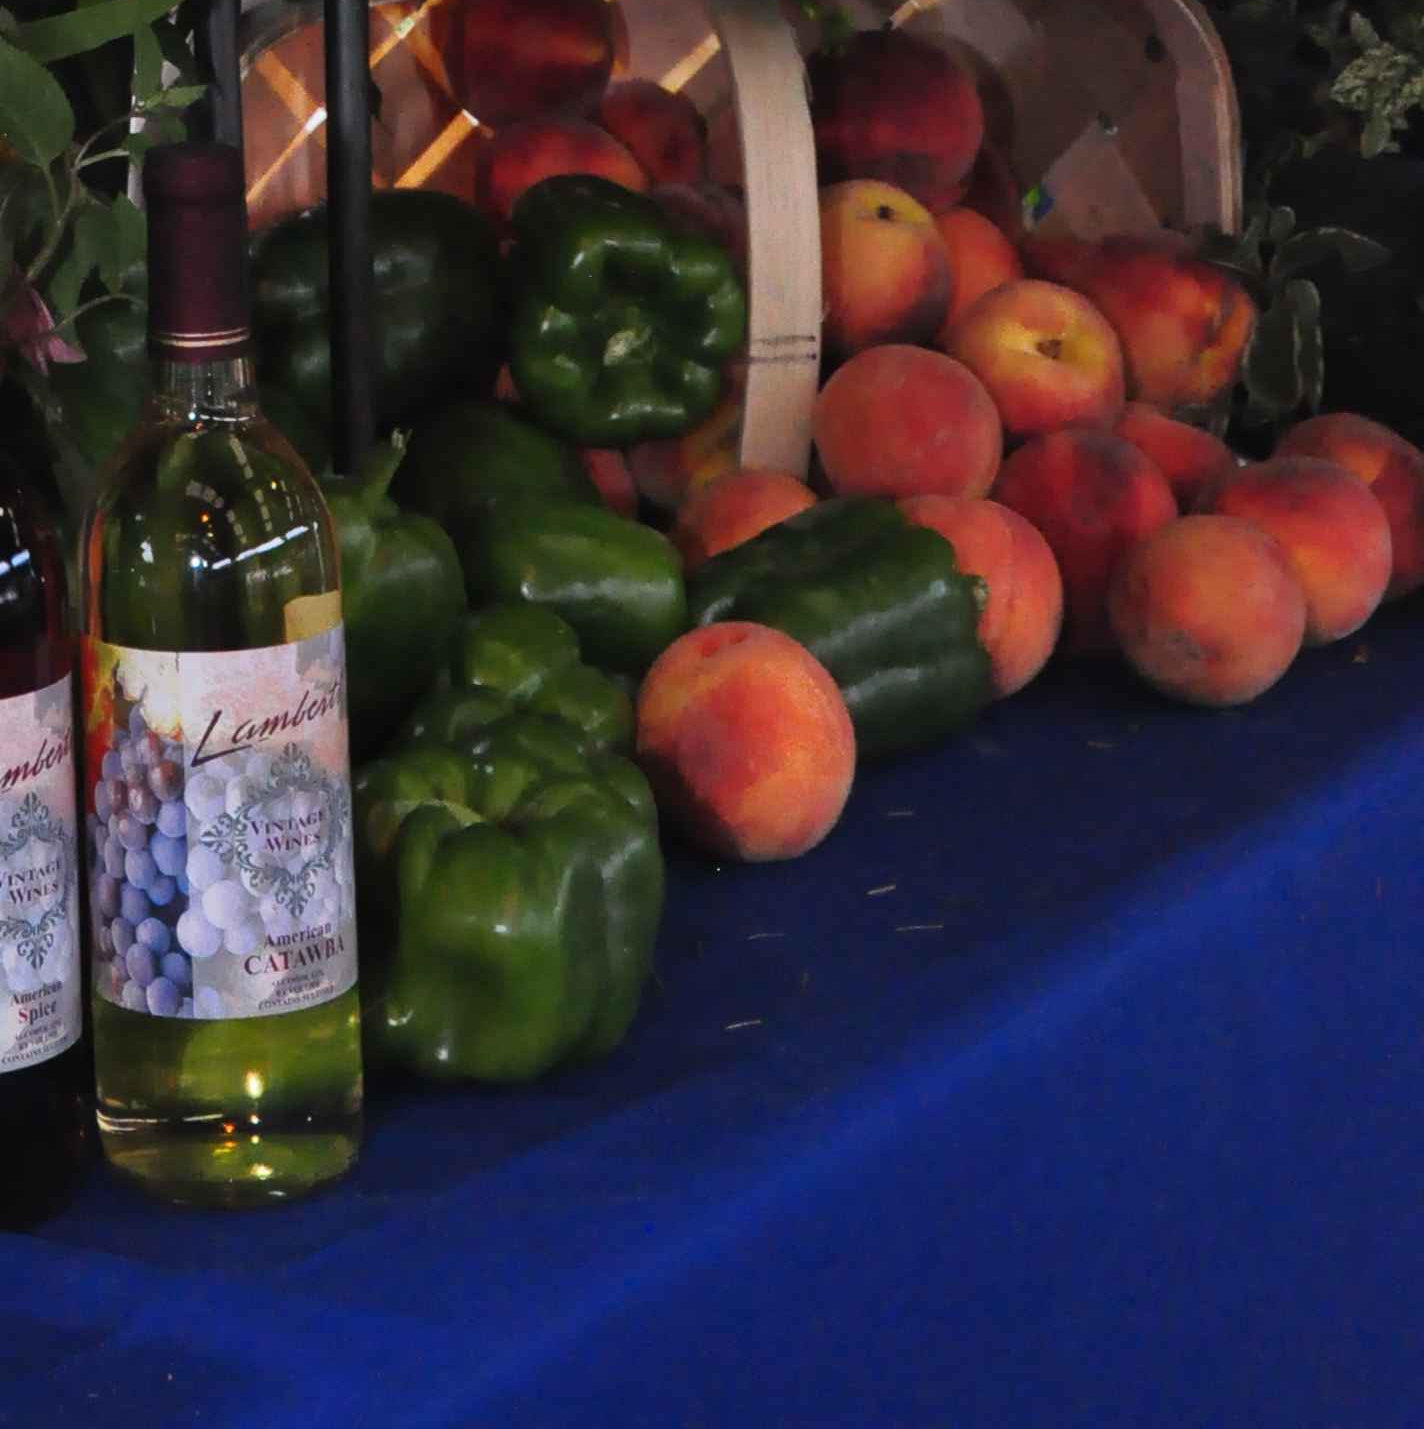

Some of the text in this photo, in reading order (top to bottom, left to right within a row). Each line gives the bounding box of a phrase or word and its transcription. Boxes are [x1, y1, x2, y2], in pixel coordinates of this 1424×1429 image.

[251, 810, 323, 835] VINTAGE
[266, 833, 321, 852] WINES
[264, 922, 333, 949] American
[244, 935, 345, 976] CATAWBA
[9, 980, 64, 1006] American
[18, 1001, 58, 1026] Spice
